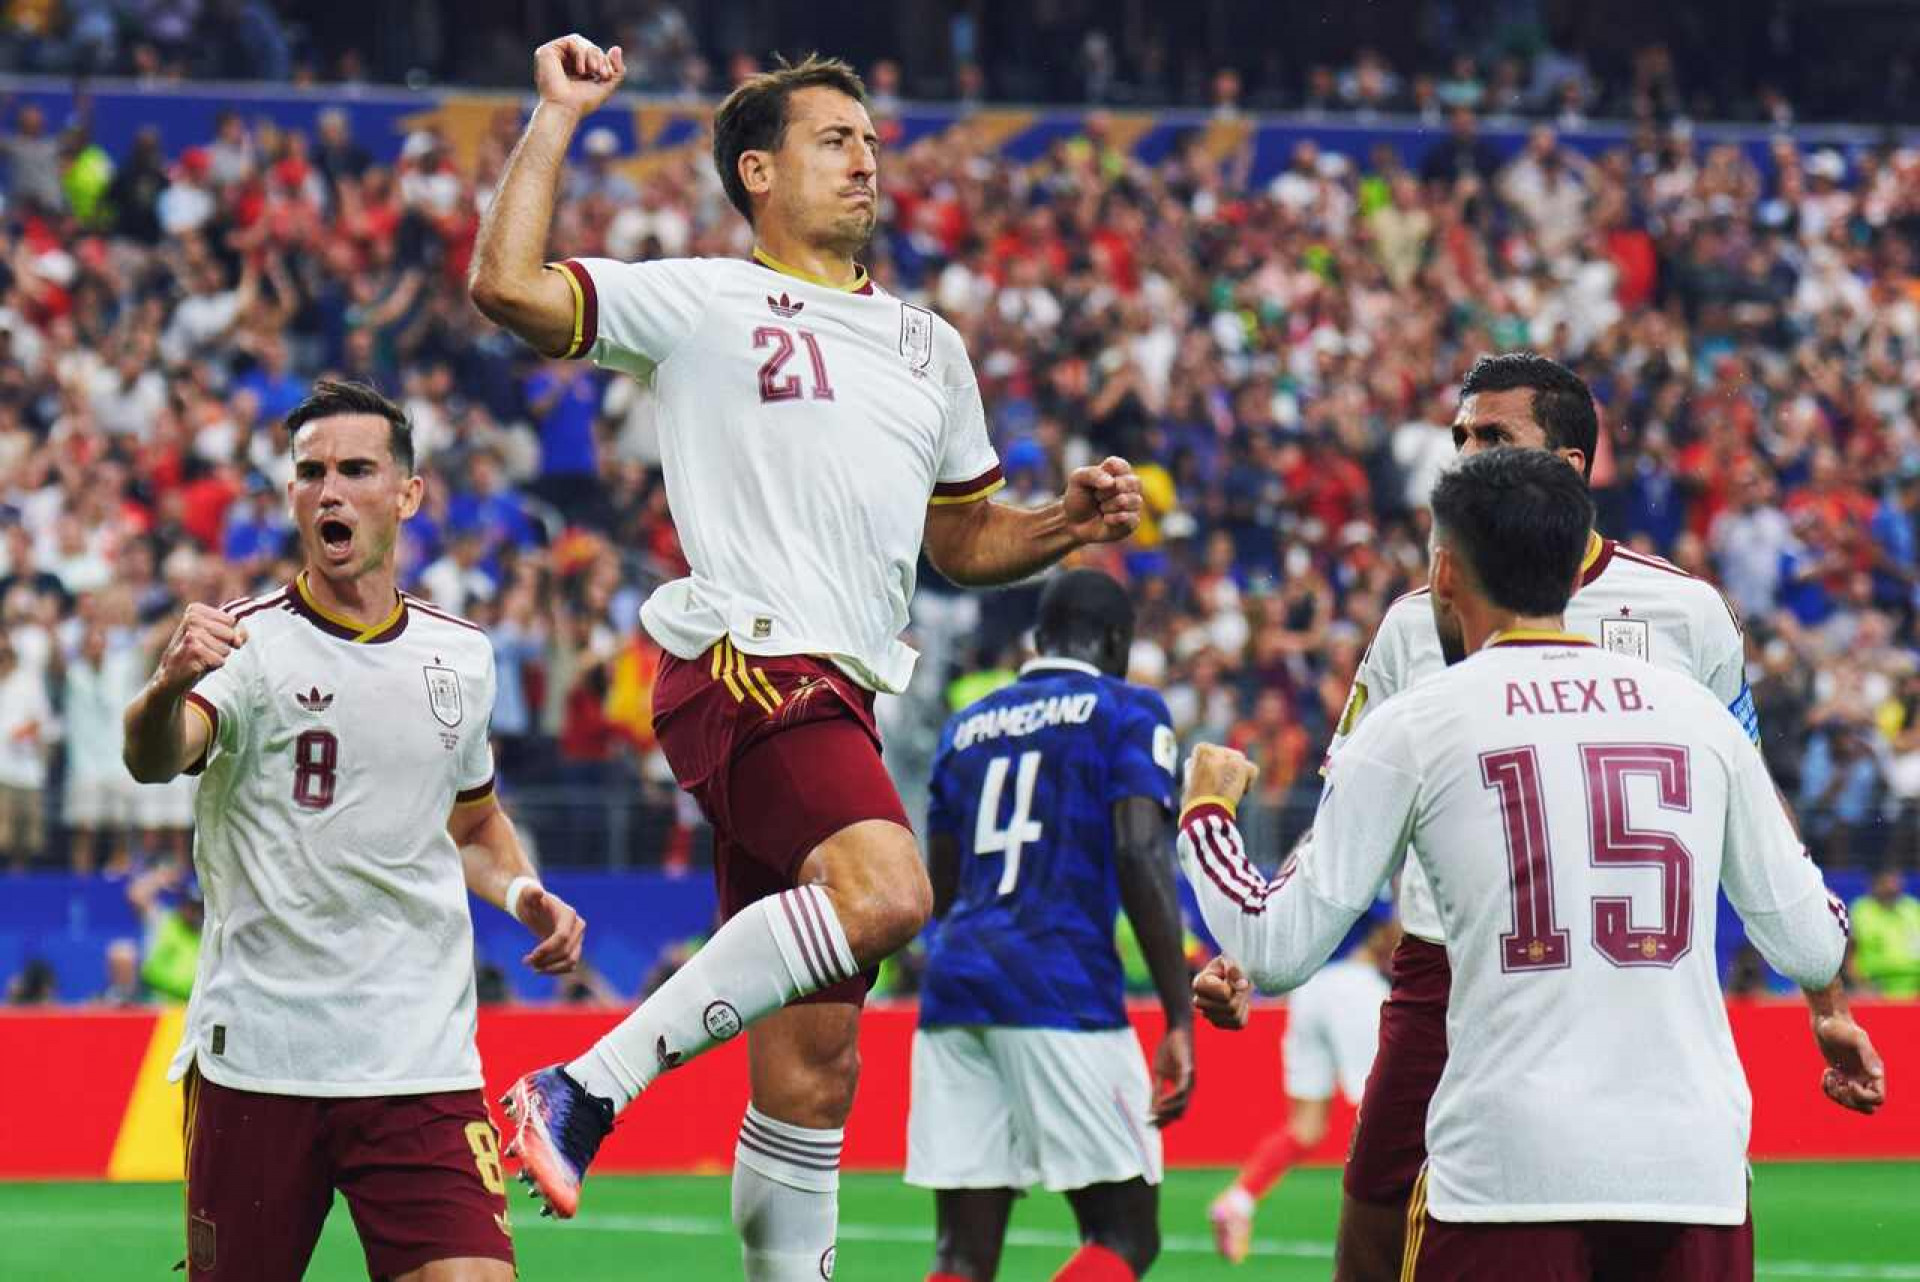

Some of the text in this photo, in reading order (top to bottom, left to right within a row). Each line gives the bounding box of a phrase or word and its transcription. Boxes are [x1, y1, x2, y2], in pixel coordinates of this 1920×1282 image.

[752, 326, 835, 403] 21
[1505, 677, 1654, 715] ALEX B.
[292, 728, 339, 811] 8
[974, 750, 1044, 896] 4
[1478, 741, 1694, 974] 15
[464, 1121, 504, 1195] 8
